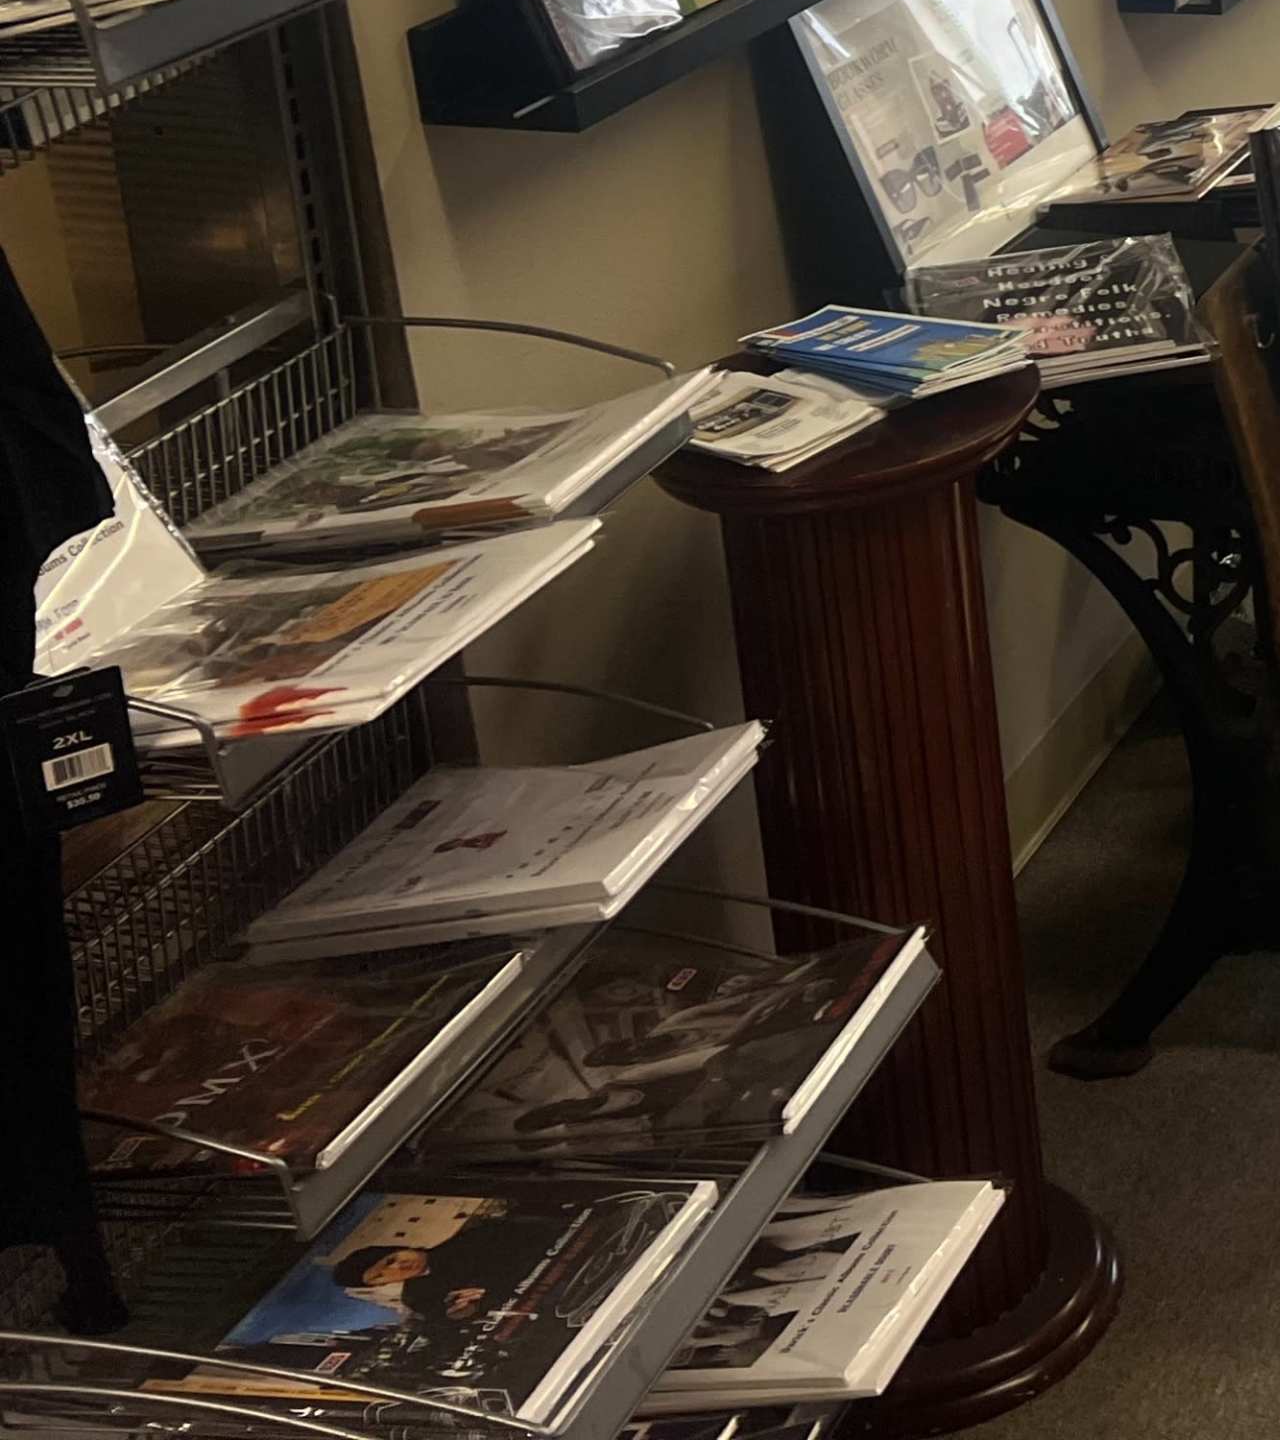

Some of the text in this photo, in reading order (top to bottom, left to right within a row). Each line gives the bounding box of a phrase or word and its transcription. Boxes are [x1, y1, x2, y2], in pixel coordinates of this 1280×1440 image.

[982, 283, 1139, 309] Negro Folk
[52, 730, 93, 750] 2XL
